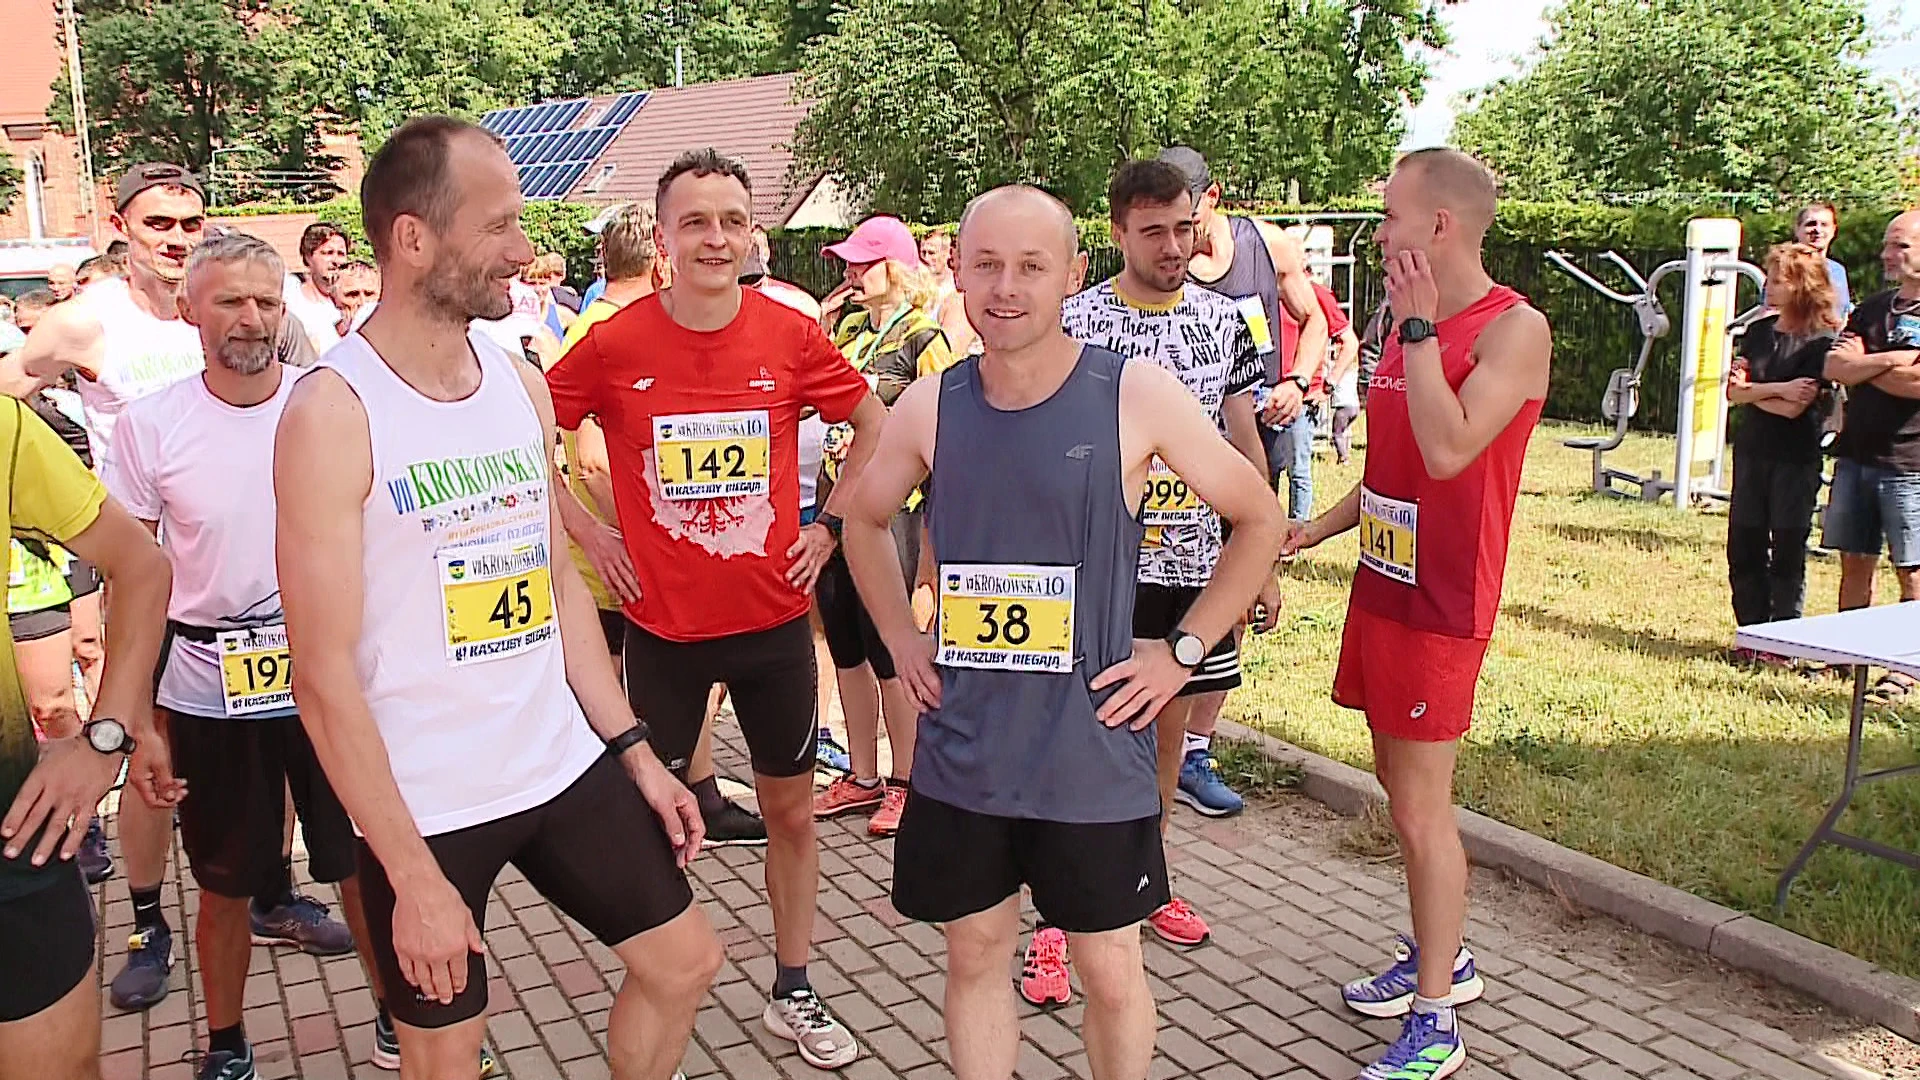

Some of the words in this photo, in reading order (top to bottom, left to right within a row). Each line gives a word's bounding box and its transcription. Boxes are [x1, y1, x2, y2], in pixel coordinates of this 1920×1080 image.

[1180, 323, 1214, 346] FAIR
[747, 419, 762, 435] 10
[681, 444, 746, 480] 142
[387, 475, 415, 515] VII
[407, 447, 541, 510] KROKOWSKA
[534, 542, 546, 567] 10
[1369, 522, 1394, 561] 141
[974, 574, 1042, 593] KROKOWSKA
[1043, 576, 1065, 595] 10
[488, 579, 532, 629] 45
[976, 604, 1031, 645] 38
[243, 653, 292, 691] 197
[956, 651, 1008, 663] KASZUBY
[1011, 654, 1061, 669] BIEGAJĄ
